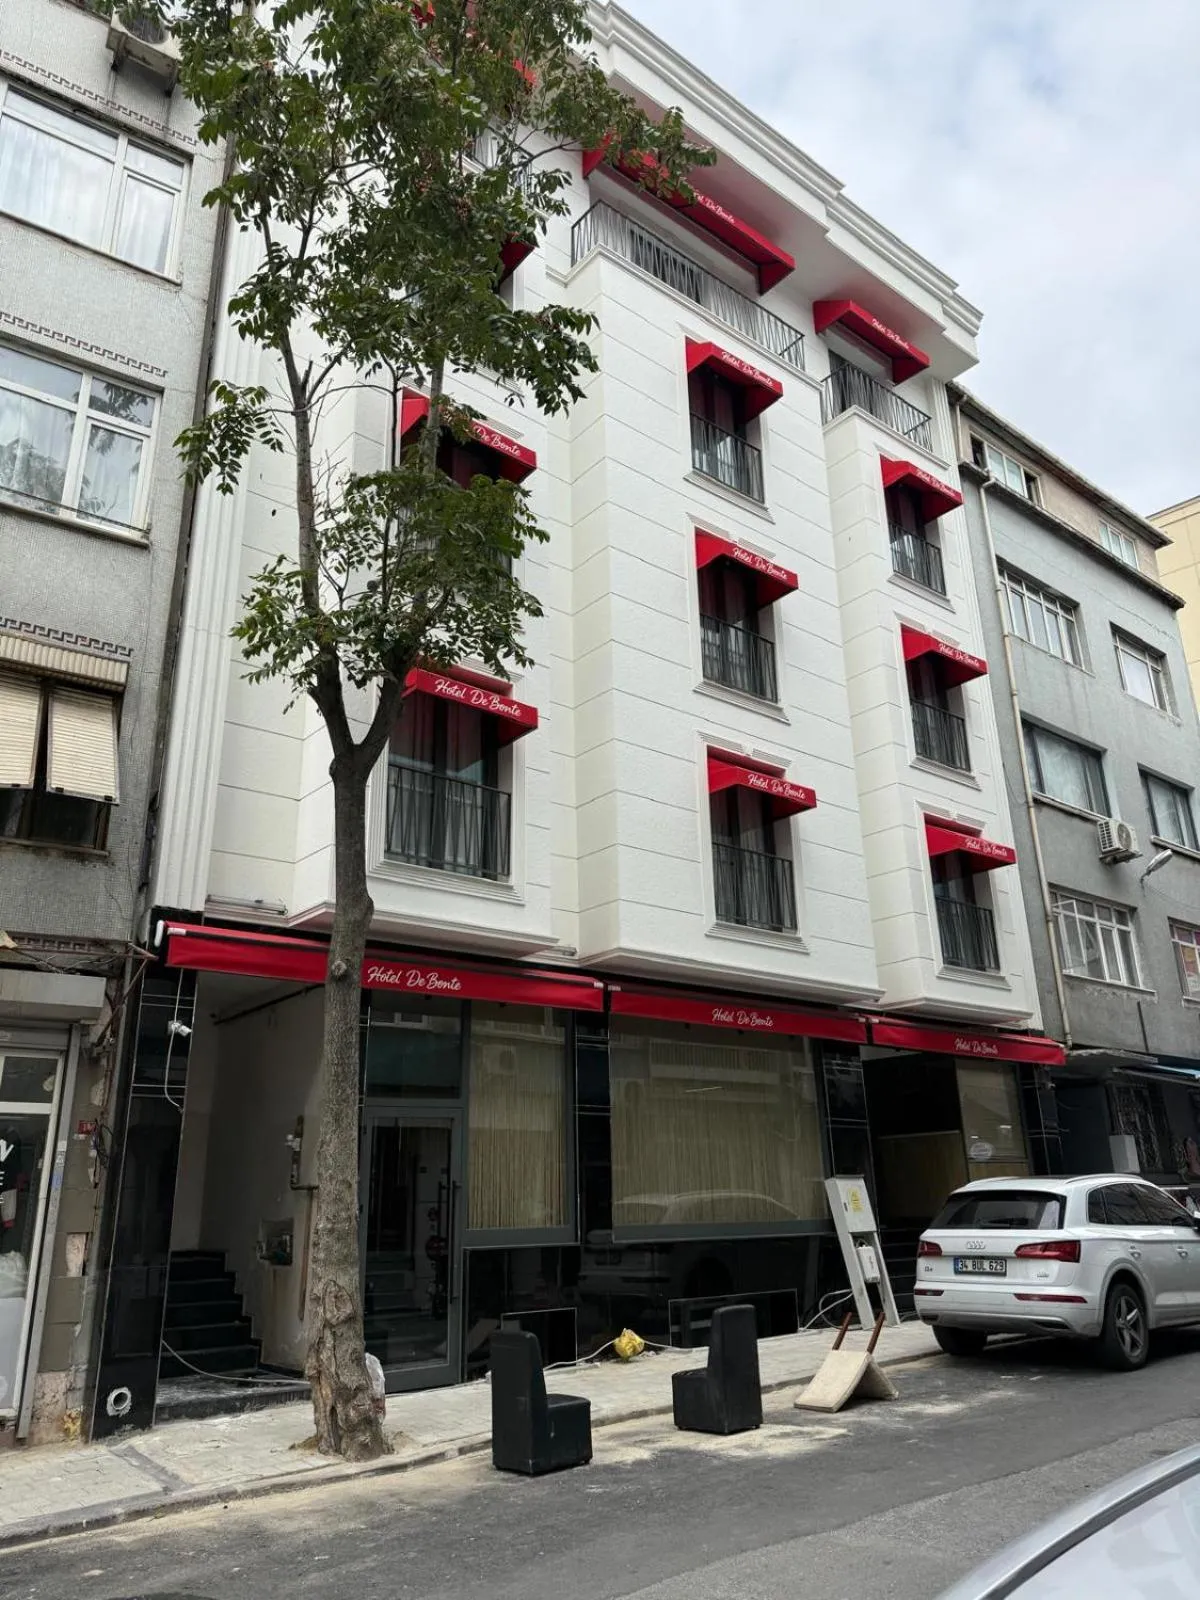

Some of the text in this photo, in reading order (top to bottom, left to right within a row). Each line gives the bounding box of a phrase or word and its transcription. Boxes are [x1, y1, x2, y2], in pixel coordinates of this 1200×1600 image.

[434, 679, 522, 716] Hotel De Bonte
[748, 773, 769, 789] Hotel
[367, 966, 462, 991] Hotel De Bonte
[712, 1008, 735, 1023] Hotel
[959, 1259, 1005, 1272] 34 BUL 629
